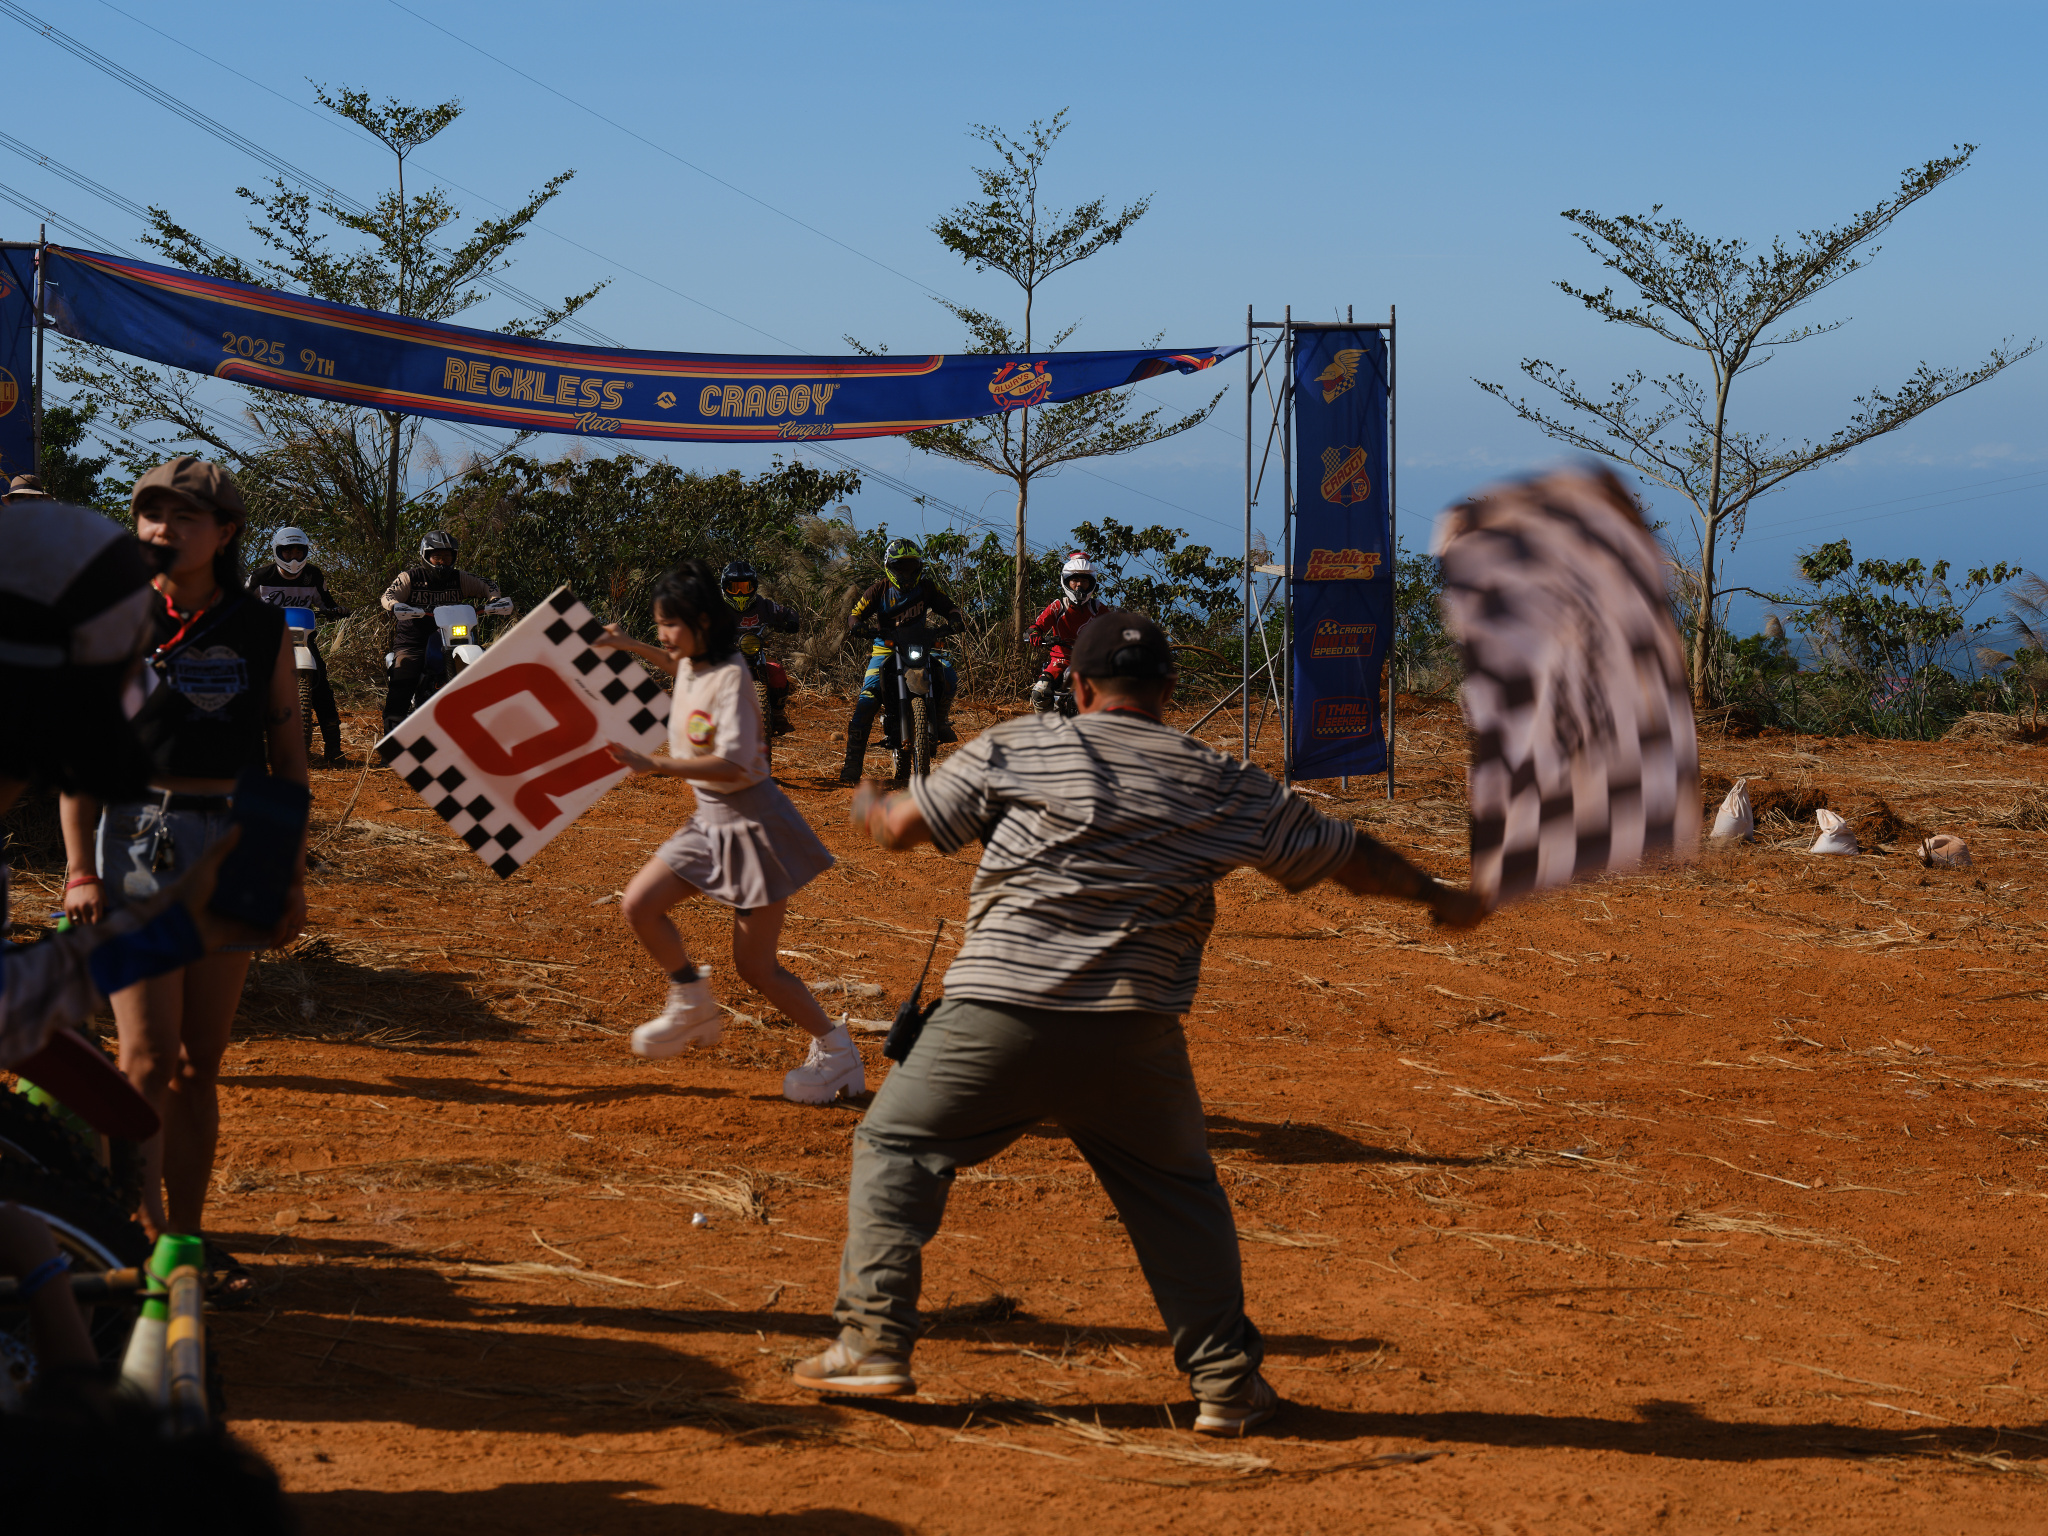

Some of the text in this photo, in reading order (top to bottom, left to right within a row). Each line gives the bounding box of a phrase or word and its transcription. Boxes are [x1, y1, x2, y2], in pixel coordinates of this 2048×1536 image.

[222, 331, 335, 376] 2025 9TH
[994, 373, 1029, 393] ALWAYS
[1018, 374, 1046, 394] LUCKY
[573, 411, 621, 432] Race
[777, 420, 834, 440] Rangers
[1323, 450, 1363, 497] CRAGGY
[265, 589, 310, 607] Deus
[1339, 626, 1375, 635] CRAGGY
[1313, 646, 1360, 656] SPEED DIV
[1315, 634, 1359, 649] MOTO
[1328, 702, 1369, 716] THRILL
[1325, 715, 1368, 728] SEEKERS
